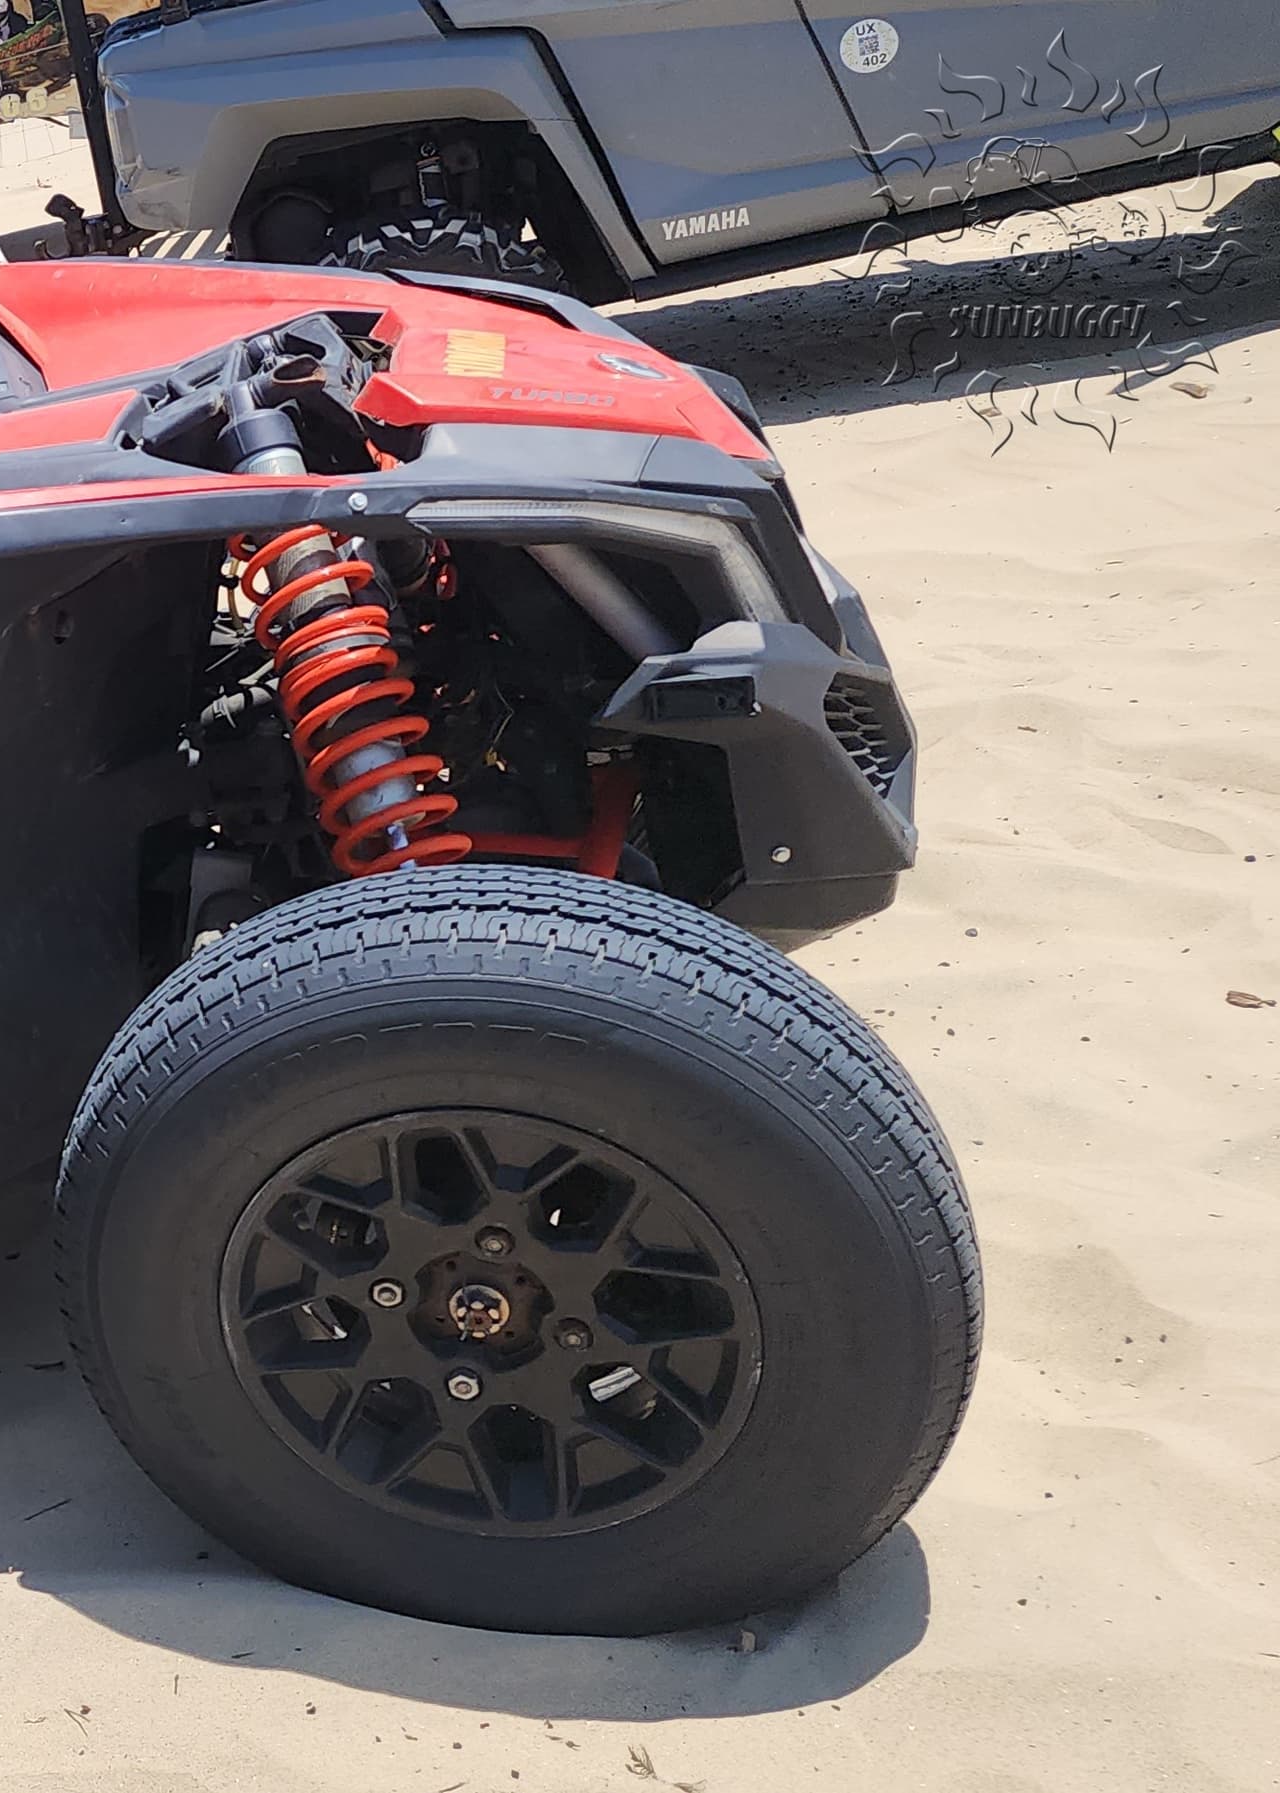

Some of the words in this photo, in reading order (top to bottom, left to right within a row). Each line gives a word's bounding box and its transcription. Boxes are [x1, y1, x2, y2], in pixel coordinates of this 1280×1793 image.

[855, 22, 876, 36] UX
[862, 52, 888, 67] 402
[661, 206, 751, 241] YAMAHA
